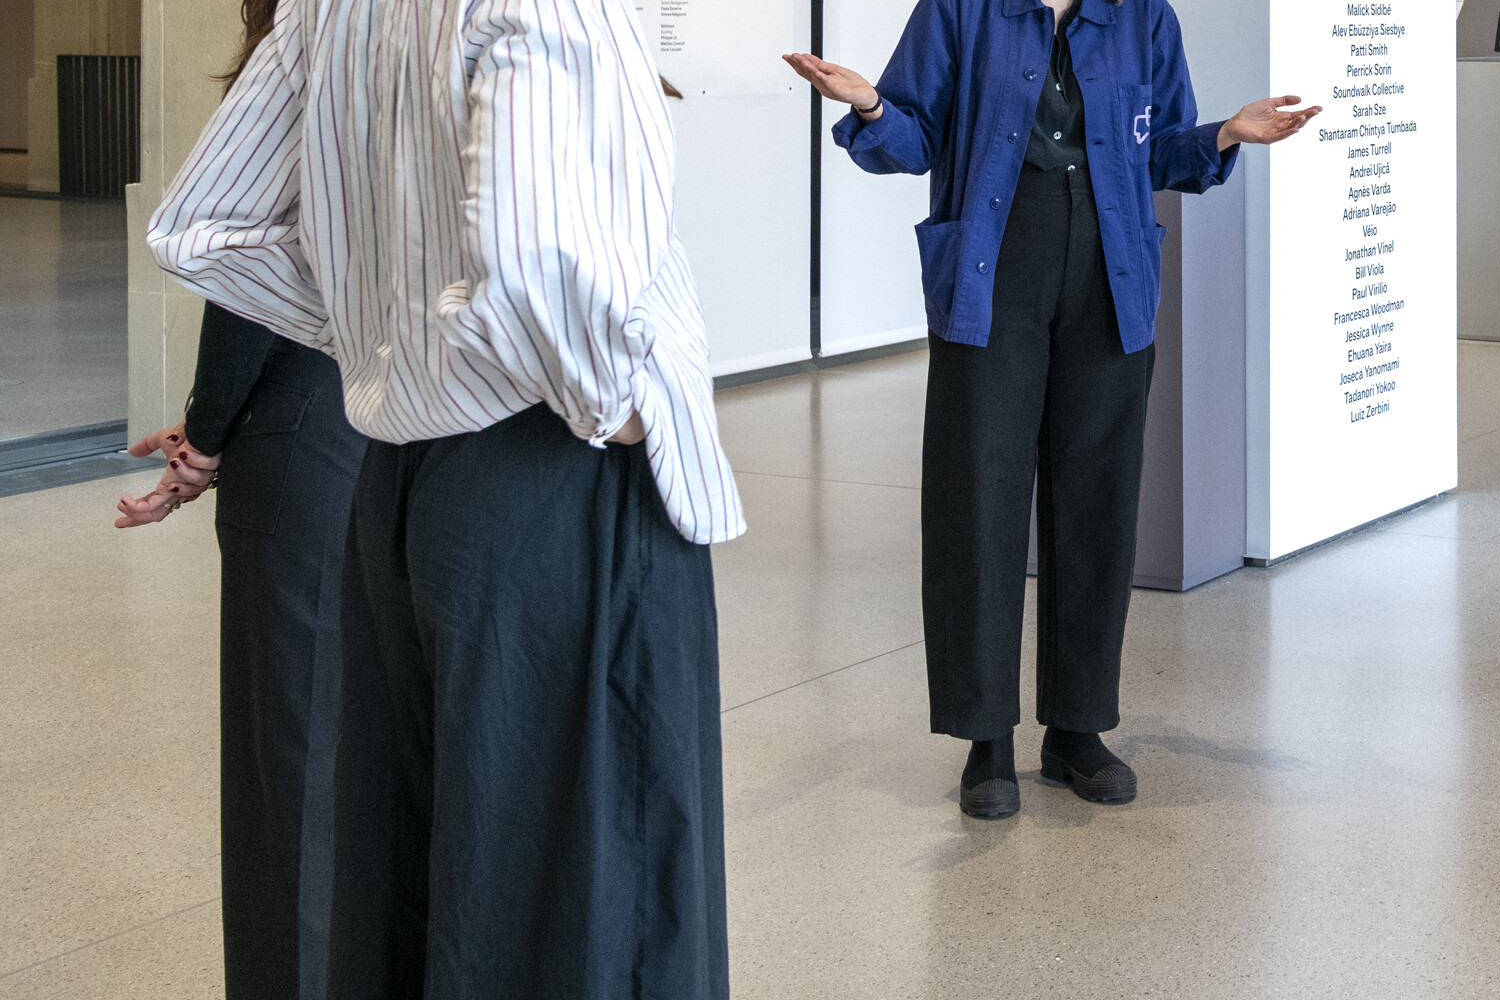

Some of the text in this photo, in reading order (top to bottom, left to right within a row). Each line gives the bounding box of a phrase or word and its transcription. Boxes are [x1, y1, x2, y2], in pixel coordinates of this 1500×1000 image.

[1347, 3, 1391, 16] Malick Sidibé
[1332, 23, 1405, 38] Alev Ebüzziya Siesbye
[1350, 43, 1387, 56] Patti Smith
[1346, 63, 1391, 76] Pierrick Sorin
[1333, 82, 1404, 98] Soundwalk Collective
[1352, 103, 1386, 117] Sarah Sze
[1318, 120, 1416, 141] Shantaram Chintya Tumbada
[1347, 142, 1391, 158] James Turrell
[1348, 182, 1390, 202] Agnès Varda
[1345, 240, 1393, 261] Jonathan Vinel
[1355, 262, 1384, 279] Bill Viola
[1352, 282, 1387, 300] Paul Virilio
[1334, 299, 1404, 325] Francesca Woodman
[1345, 322, 1393, 342] Jessica Wynne
[1348, 341, 1391, 362] Ehuana Yaira
[1339, 357, 1399, 385] Joseca Yanomami
[1344, 380, 1395, 404] Tadanori Yokoo
[1350, 399, 1389, 422] Luiz Zerbini
